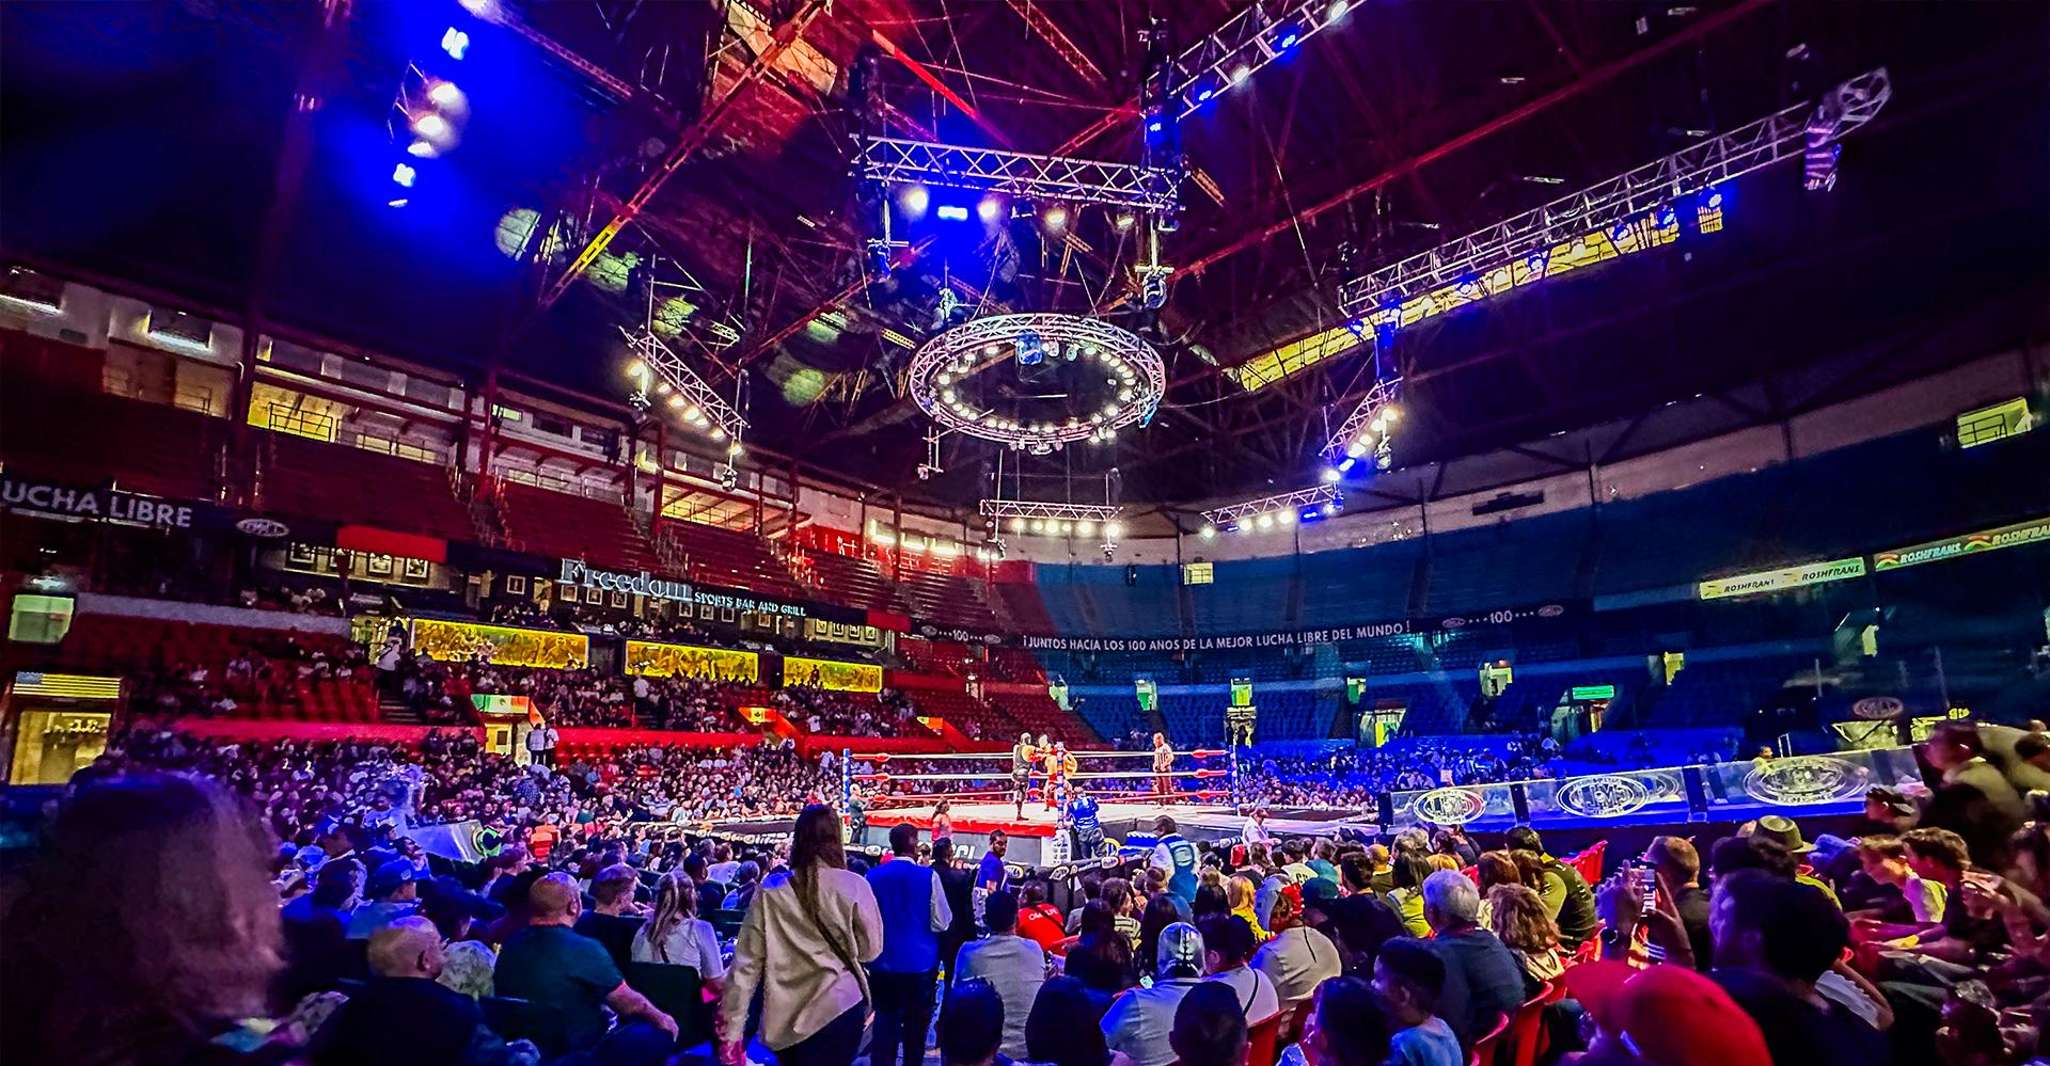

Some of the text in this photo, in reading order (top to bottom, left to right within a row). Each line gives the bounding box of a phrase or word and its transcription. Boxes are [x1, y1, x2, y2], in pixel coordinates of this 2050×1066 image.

[110, 496, 193, 528] LIBRE
[1992, 525, 2050, 546] ROSHFRA
[1900, 543, 1961, 563] ROSHFRANS
[1801, 564, 1860, 581] ROSHFRANS
[554, 558, 807, 616] Freedom SPORTS BAR AND GRILL
[1490, 610, 1513, 624] 100
[952, 629, 969, 641] 100
[1070, 639, 1101, 650] HACIA
[1104, 640, 1125, 651] LOS
[1128, 640, 1147, 651] 100
[1183, 639, 1197, 650] DE
[1199, 638, 1214, 650] LA
[1216, 636, 1253, 649] MEJOR
[1256, 632, 1294, 647] LUCHA
[1297, 630, 1329, 644] LIBRE
[1332, 628, 1353, 640] DEL
